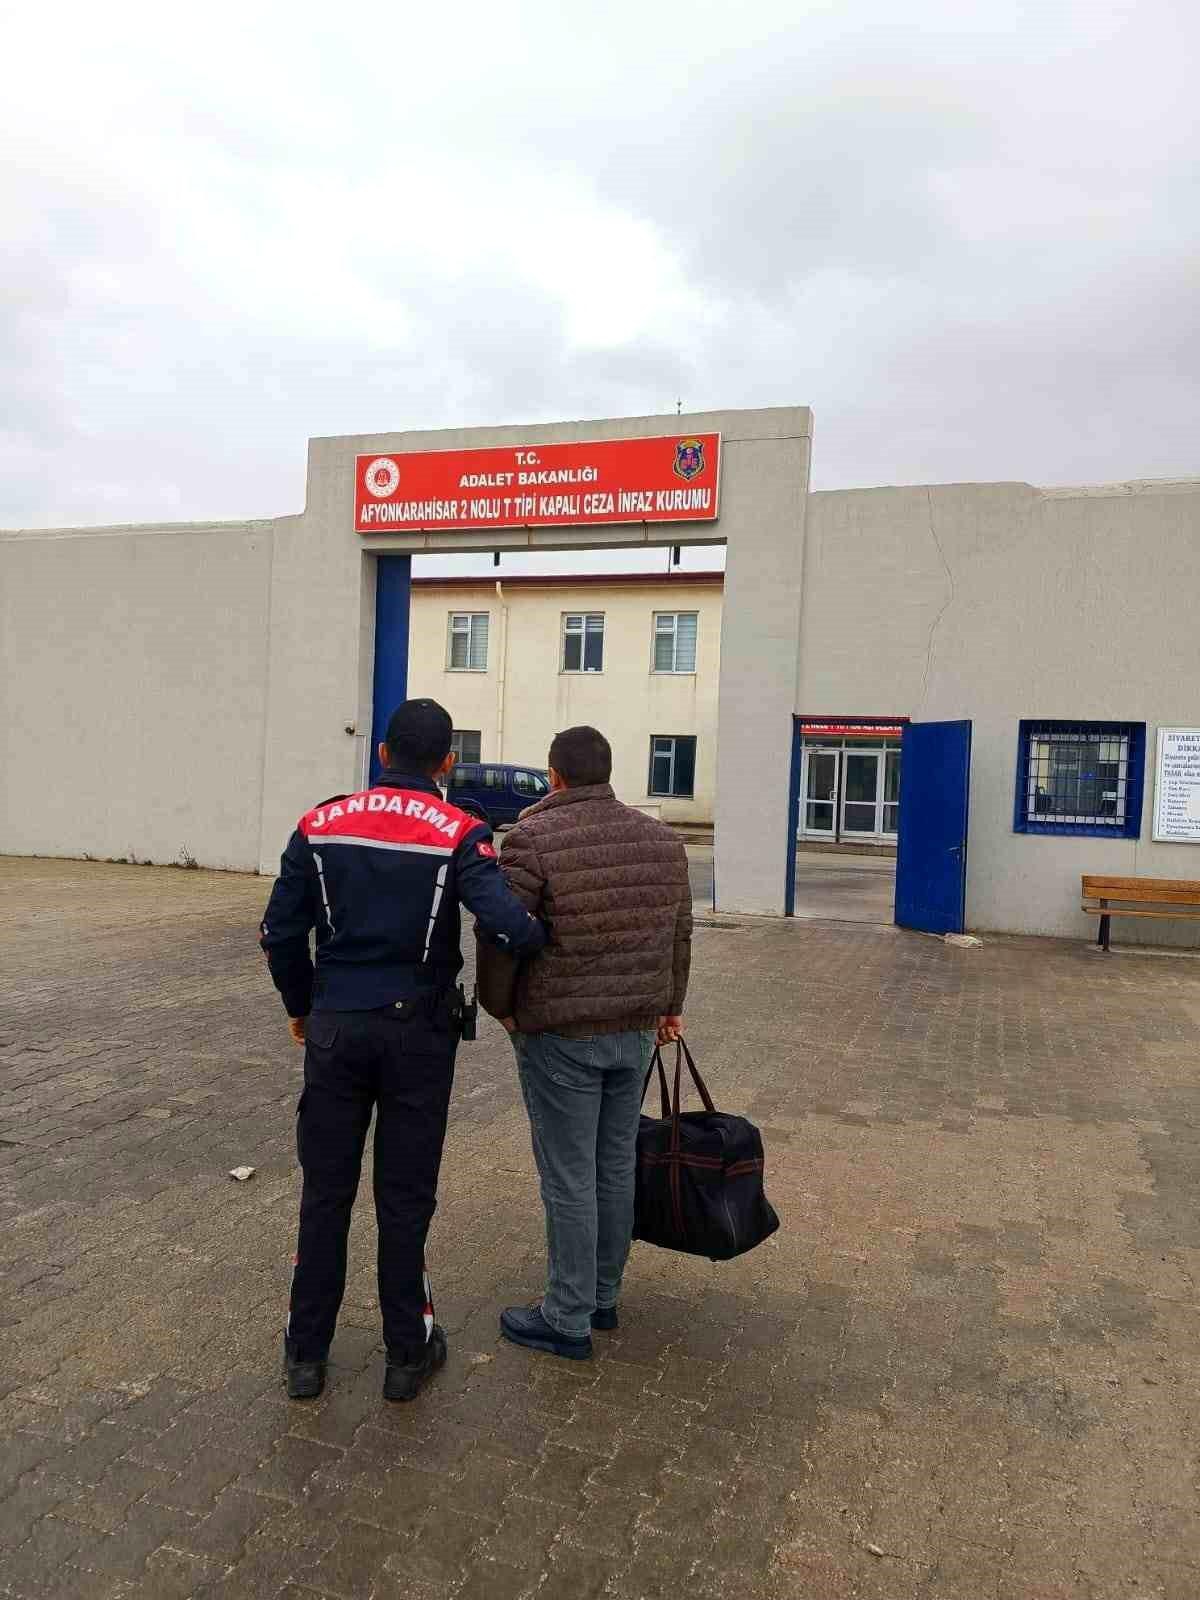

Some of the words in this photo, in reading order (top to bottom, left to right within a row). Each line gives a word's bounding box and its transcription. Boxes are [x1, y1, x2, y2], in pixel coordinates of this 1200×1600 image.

[515, 451, 541, 465] T.C.
[459, 472, 514, 488] ADALET
[518, 466, 598, 486] BAKANLIĞI
[360, 496, 459, 523] AFYONKARAHİSAR
[460, 499, 468, 520] 2
[470, 497, 501, 520] NOLU
[503, 497, 512, 518] T
[514, 492, 537, 517] TİPİ
[539, 495, 581, 516] KAPALI
[583, 493, 615, 514] CEZA
[617, 487, 654, 513] İNFAZ
[656, 488, 711, 510] KURUMU
[310, 794, 462, 839] JANDARMA
